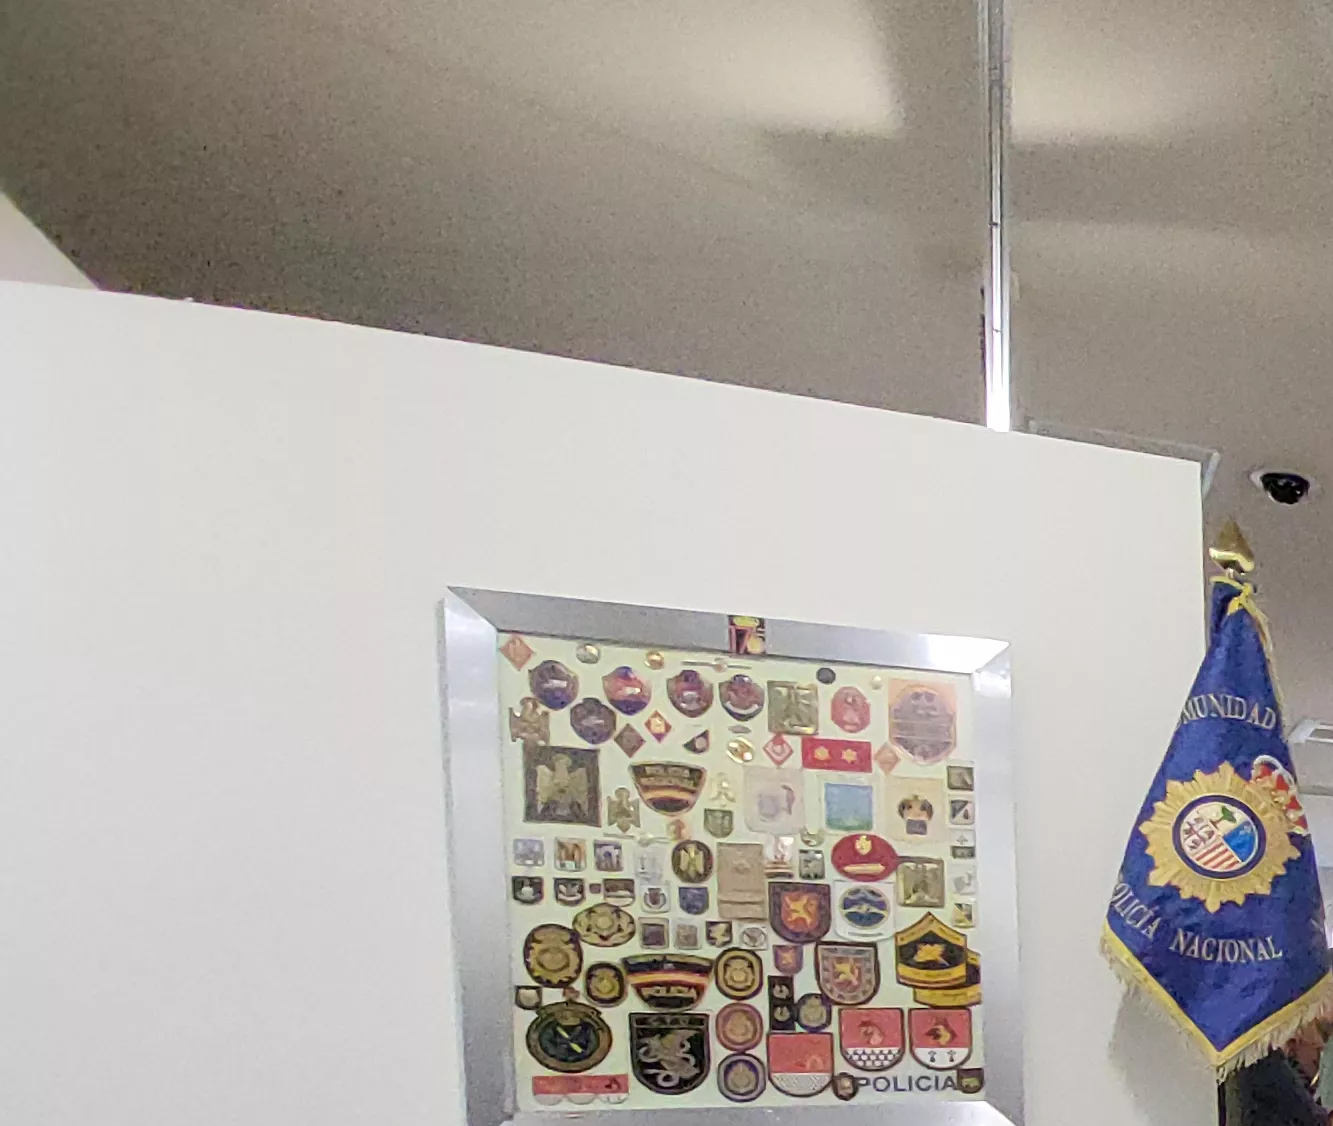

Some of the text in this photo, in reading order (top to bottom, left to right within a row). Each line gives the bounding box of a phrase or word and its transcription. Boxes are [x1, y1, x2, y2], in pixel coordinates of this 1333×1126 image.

[1178, 693, 1276, 729] MUNIDAD
[1169, 928, 1283, 962] NACIONAL
[856, 1076, 957, 1092] POLICIA
